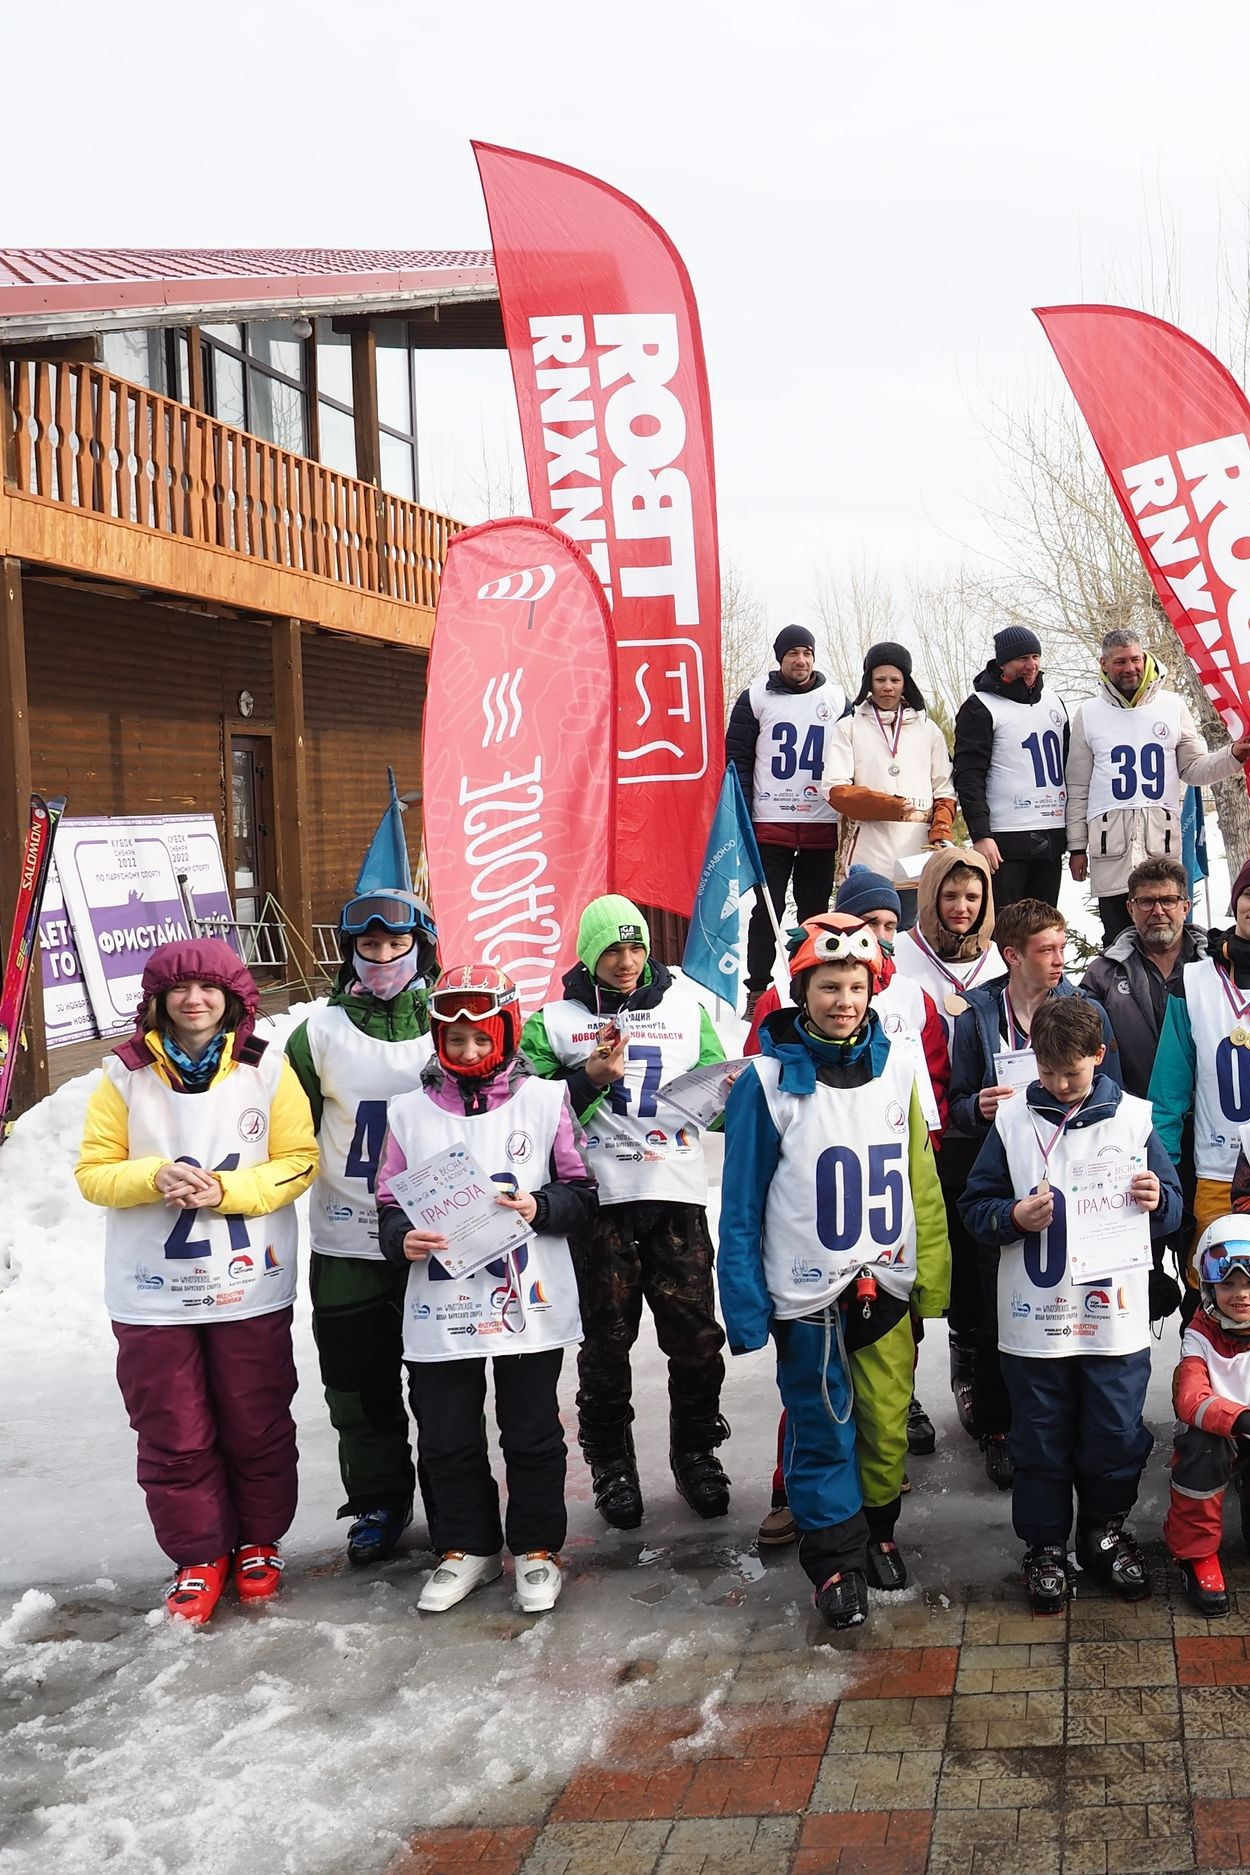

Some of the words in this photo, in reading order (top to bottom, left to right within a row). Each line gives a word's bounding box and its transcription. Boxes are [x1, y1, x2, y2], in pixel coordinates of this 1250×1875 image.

[771, 722, 825, 780] 34
[1021, 730, 1063, 788] 10
[1111, 743, 1165, 800] 39
[21, 821, 43, 891] SALOMON
[118, 858, 137, 868] 2022
[173, 854, 190, 862] 2022
[98, 917, 189, 954] ФРИСТАЙЛ
[50, 952, 82, 979] ГО
[345, 1100, 391, 1194] 4
[420, 1184, 486, 1224] ГРАМОТА
[816, 1143, 904, 1251] 05
[1078, 1192, 1137, 1215] ГРАМОТА
